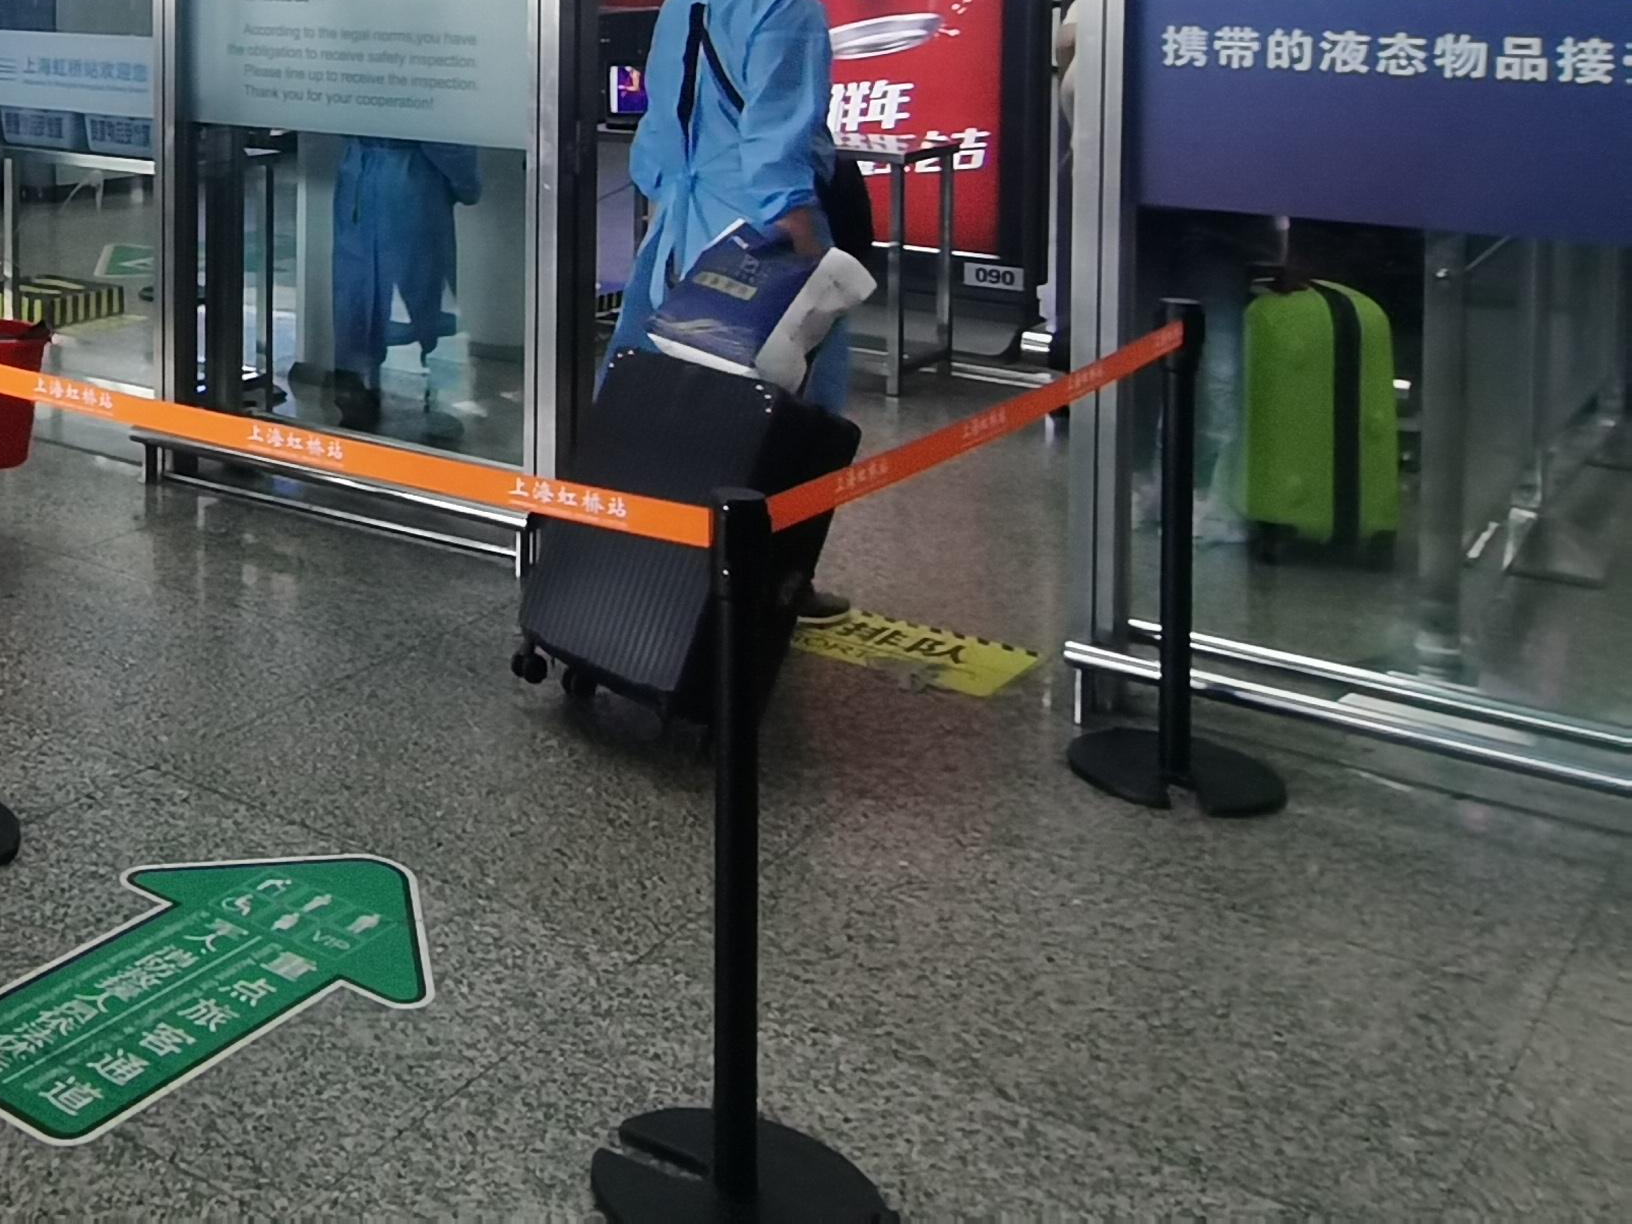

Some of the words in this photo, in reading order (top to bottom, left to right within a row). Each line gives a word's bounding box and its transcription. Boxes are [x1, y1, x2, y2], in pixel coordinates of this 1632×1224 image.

[1162, 24, 1632, 85] 携带的液态物品接
[975, 267, 1015, 286] 090
[33, 377, 114, 410] 上海虹桥站
[247, 424, 344, 460] 上海虹桥站
[508, 477, 628, 518] 上海虹桥站
[313, 930, 350, 951] VIP
